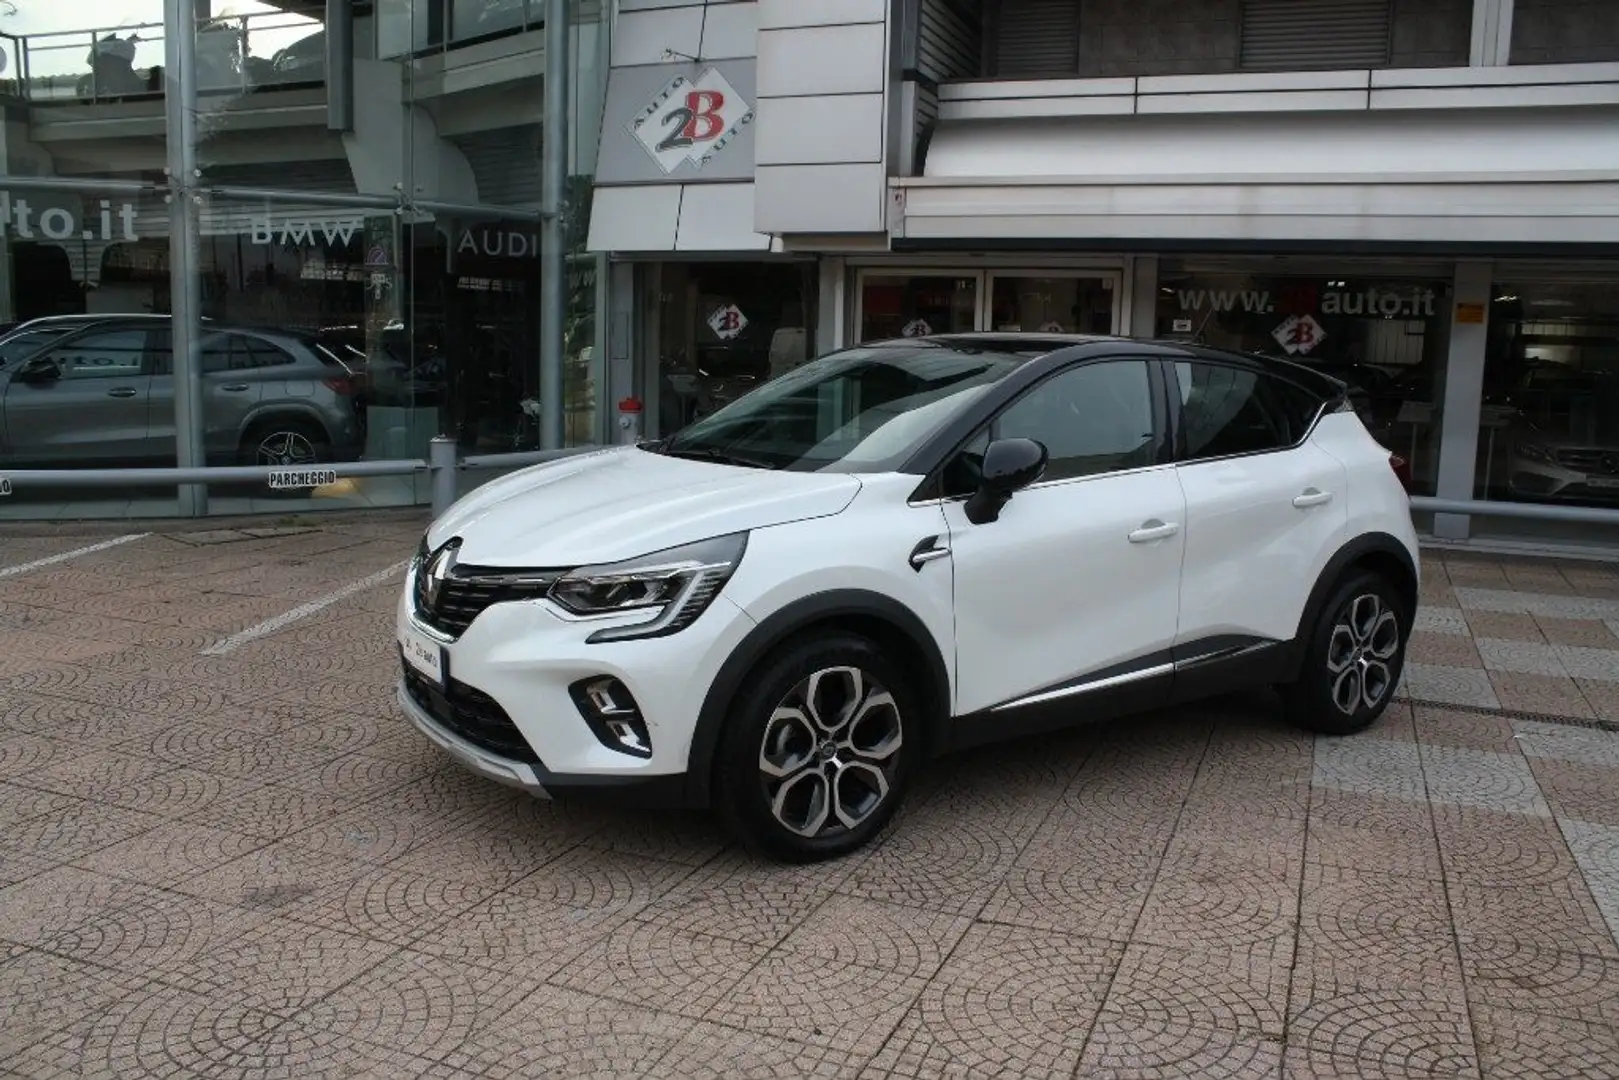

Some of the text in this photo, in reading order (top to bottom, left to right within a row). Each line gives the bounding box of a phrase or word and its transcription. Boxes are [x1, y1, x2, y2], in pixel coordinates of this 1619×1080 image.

[633, 76, 685, 129] AUTO
[654, 90, 725, 152] 2B
[0, 198, 138, 241] to.it
[251, 218, 357, 247] BMW
[456, 229, 537, 257] AUDI
[1177, 286, 1436, 316] www.auto.it
[1286, 321, 1314, 345] 2B
[270, 471, 336, 488] PARCHEGGIO
